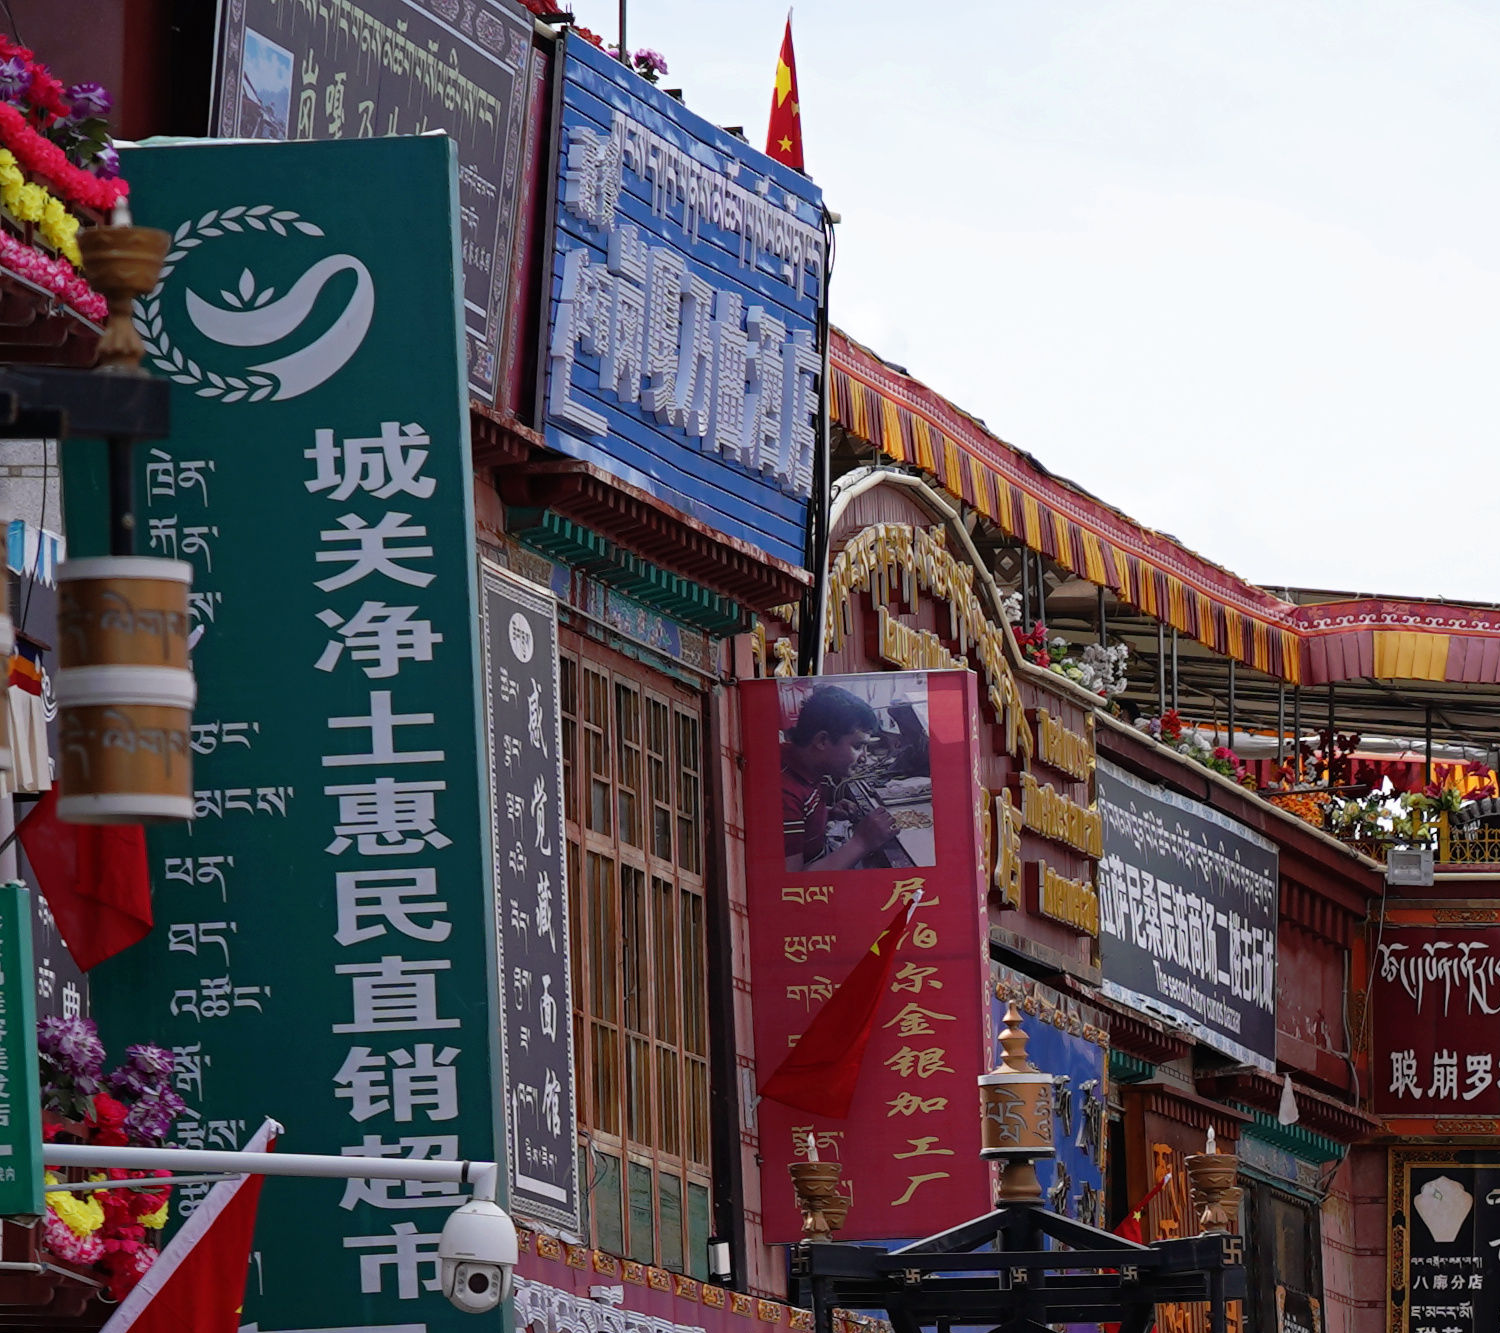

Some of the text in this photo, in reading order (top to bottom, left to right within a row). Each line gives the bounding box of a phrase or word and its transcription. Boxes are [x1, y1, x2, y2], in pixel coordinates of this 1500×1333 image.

[304, 421, 472, 1299] 城关净土惠民直销超市
[528, 677, 561, 1138] 感觉藏面馆
[881, 877, 957, 1206] 尼泊尔金银加工厂
